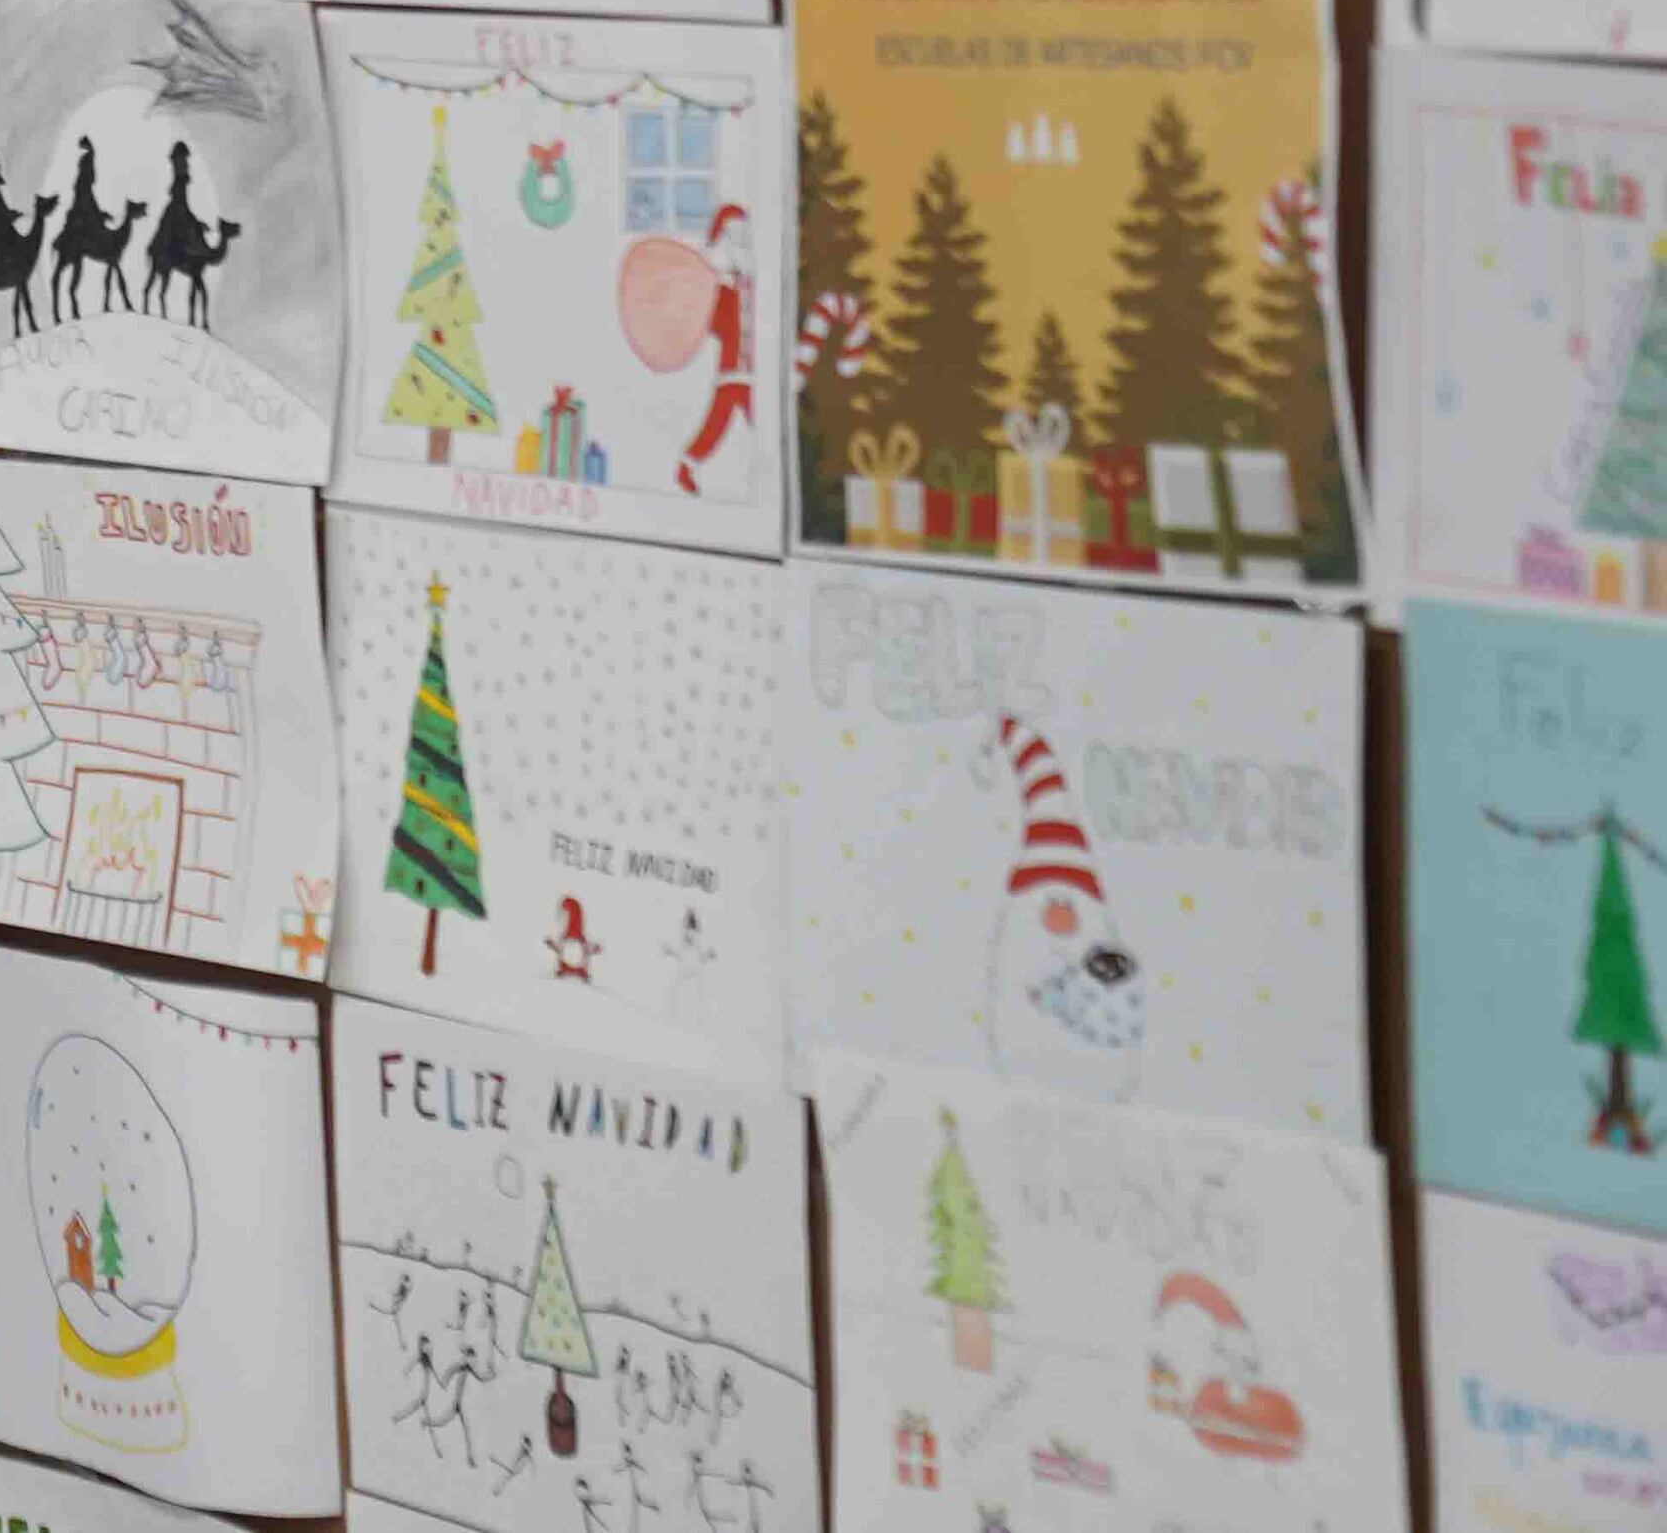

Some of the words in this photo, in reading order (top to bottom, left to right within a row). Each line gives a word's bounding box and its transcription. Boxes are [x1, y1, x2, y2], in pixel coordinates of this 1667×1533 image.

[475, 26, 576, 68] FELIZ
[95, 484, 253, 558] ILUSIÓN
[451, 473, 601, 522] NAVIDAD
[377, 1051, 510, 1132] FELIZ
[547, 1079, 749, 1175] NAVIDAD
